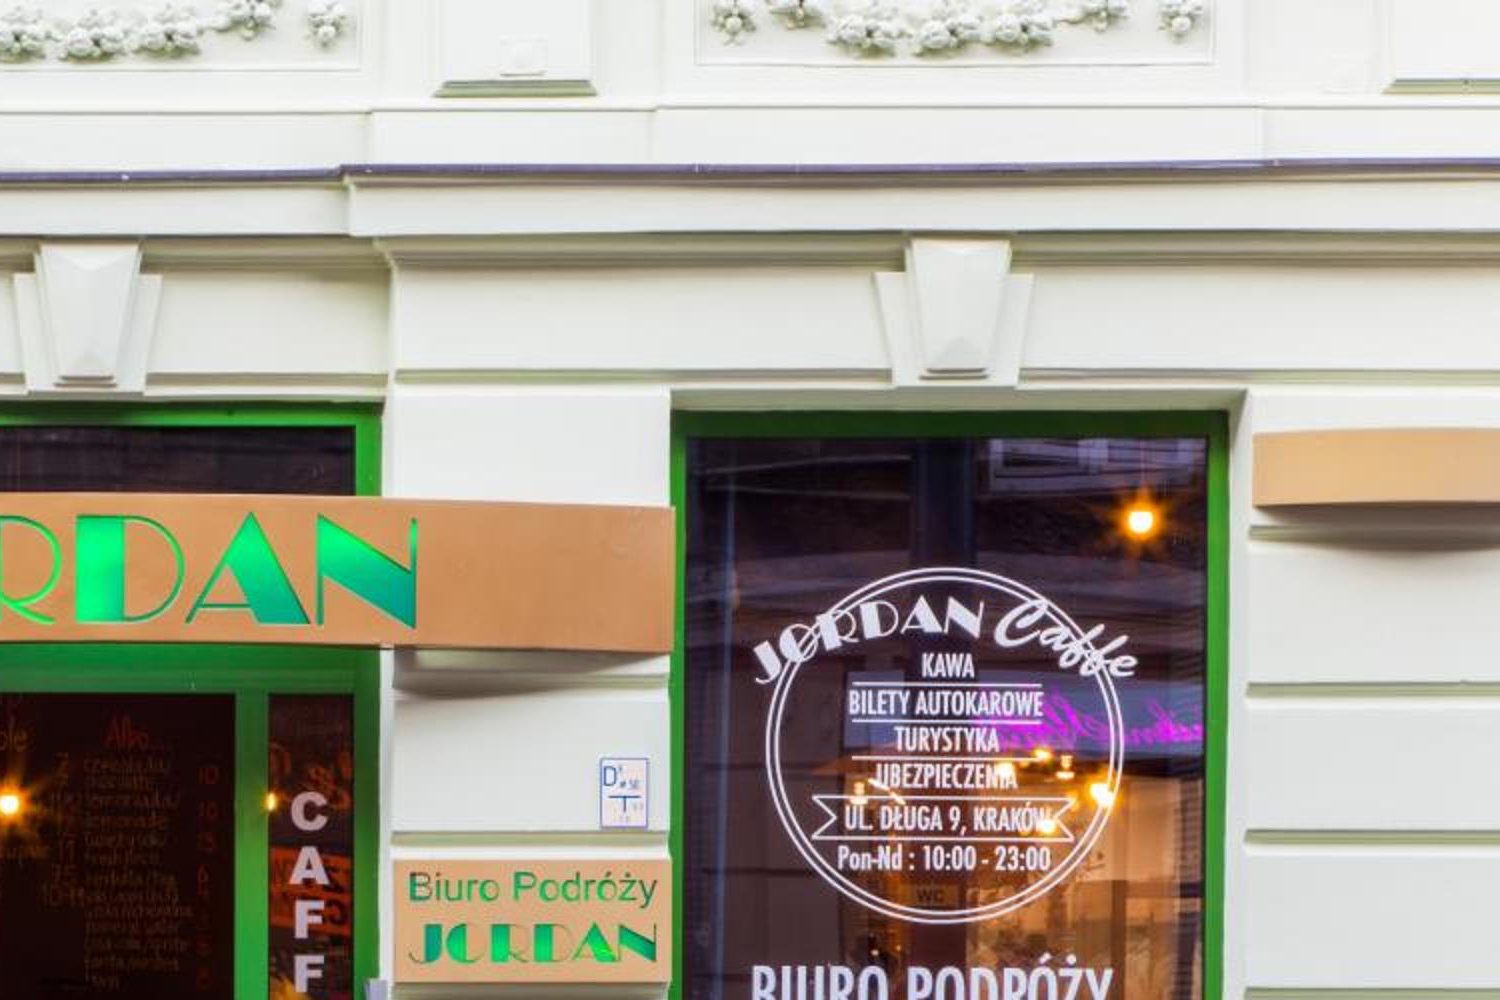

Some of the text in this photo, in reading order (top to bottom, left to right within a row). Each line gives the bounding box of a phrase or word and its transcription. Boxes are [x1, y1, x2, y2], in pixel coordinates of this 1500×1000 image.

[753, 594, 1139, 684] JORDAN Caffe
[921, 652, 975, 678] KAWA
[849, 690, 1044, 717] BILETY AUTOKAROWE
[894, 726, 1000, 753] TURYSTYKA
[875, 763, 1018, 790] UBEZPIECZENIA
[844, 802, 1054, 836] UL. DŁUGA 9, KRAKÓW
[837, 844, 903, 870] Pon-Nd
[924, 846, 976, 871] 10:00
[995, 846, 1051, 871] 23:00
[408, 871, 658, 909] Biuro Podróży
[408, 921, 658, 965] JORDAN
